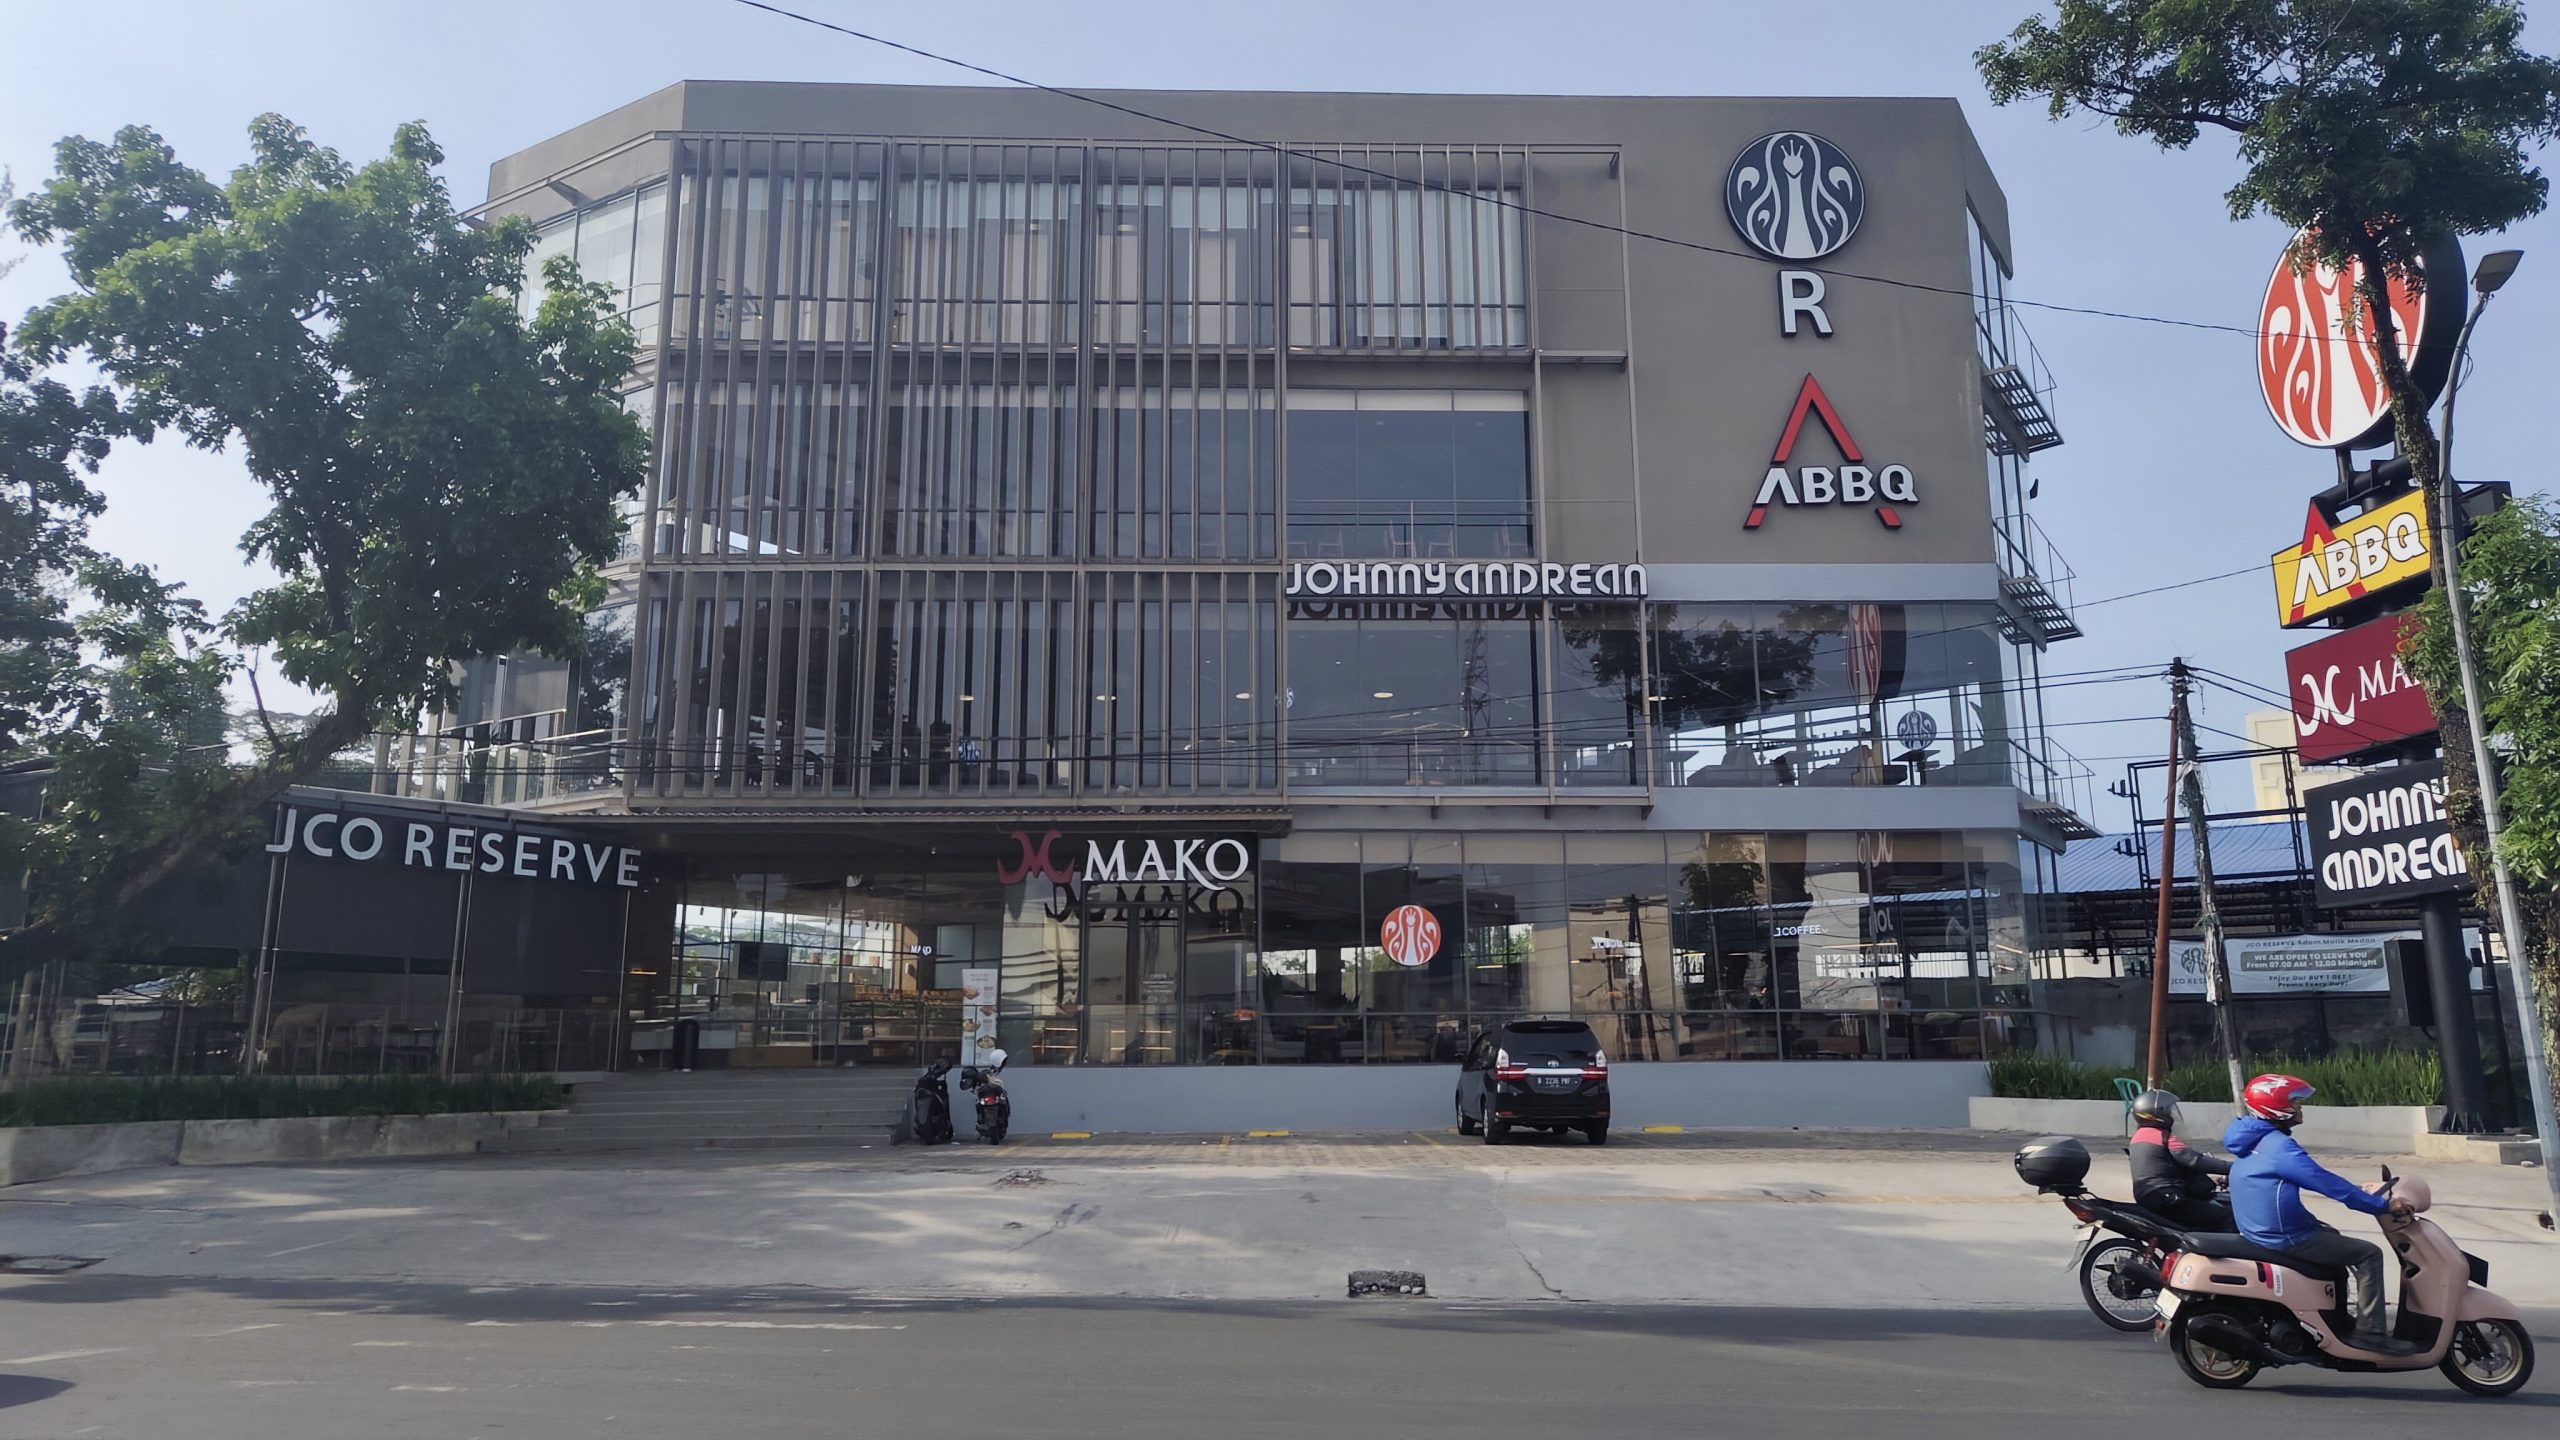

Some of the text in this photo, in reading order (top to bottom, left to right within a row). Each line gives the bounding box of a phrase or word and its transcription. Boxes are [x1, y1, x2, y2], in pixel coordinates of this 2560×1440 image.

[1779, 270, 1833, 337] R
[2293, 512, 2428, 606] ABBQ
[2358, 656, 2421, 702] MA
[265, 808, 642, 887] JCO RESERVE
[1082, 838, 1249, 891] MAKO
[2246, 961, 2268, 969] From
[2293, 960, 2307, 968] AM
[2338, 958, 2377, 967] Midnight
[2322, 952, 2348, 960] SERVE
[2349, 951, 2367, 959] YOU
